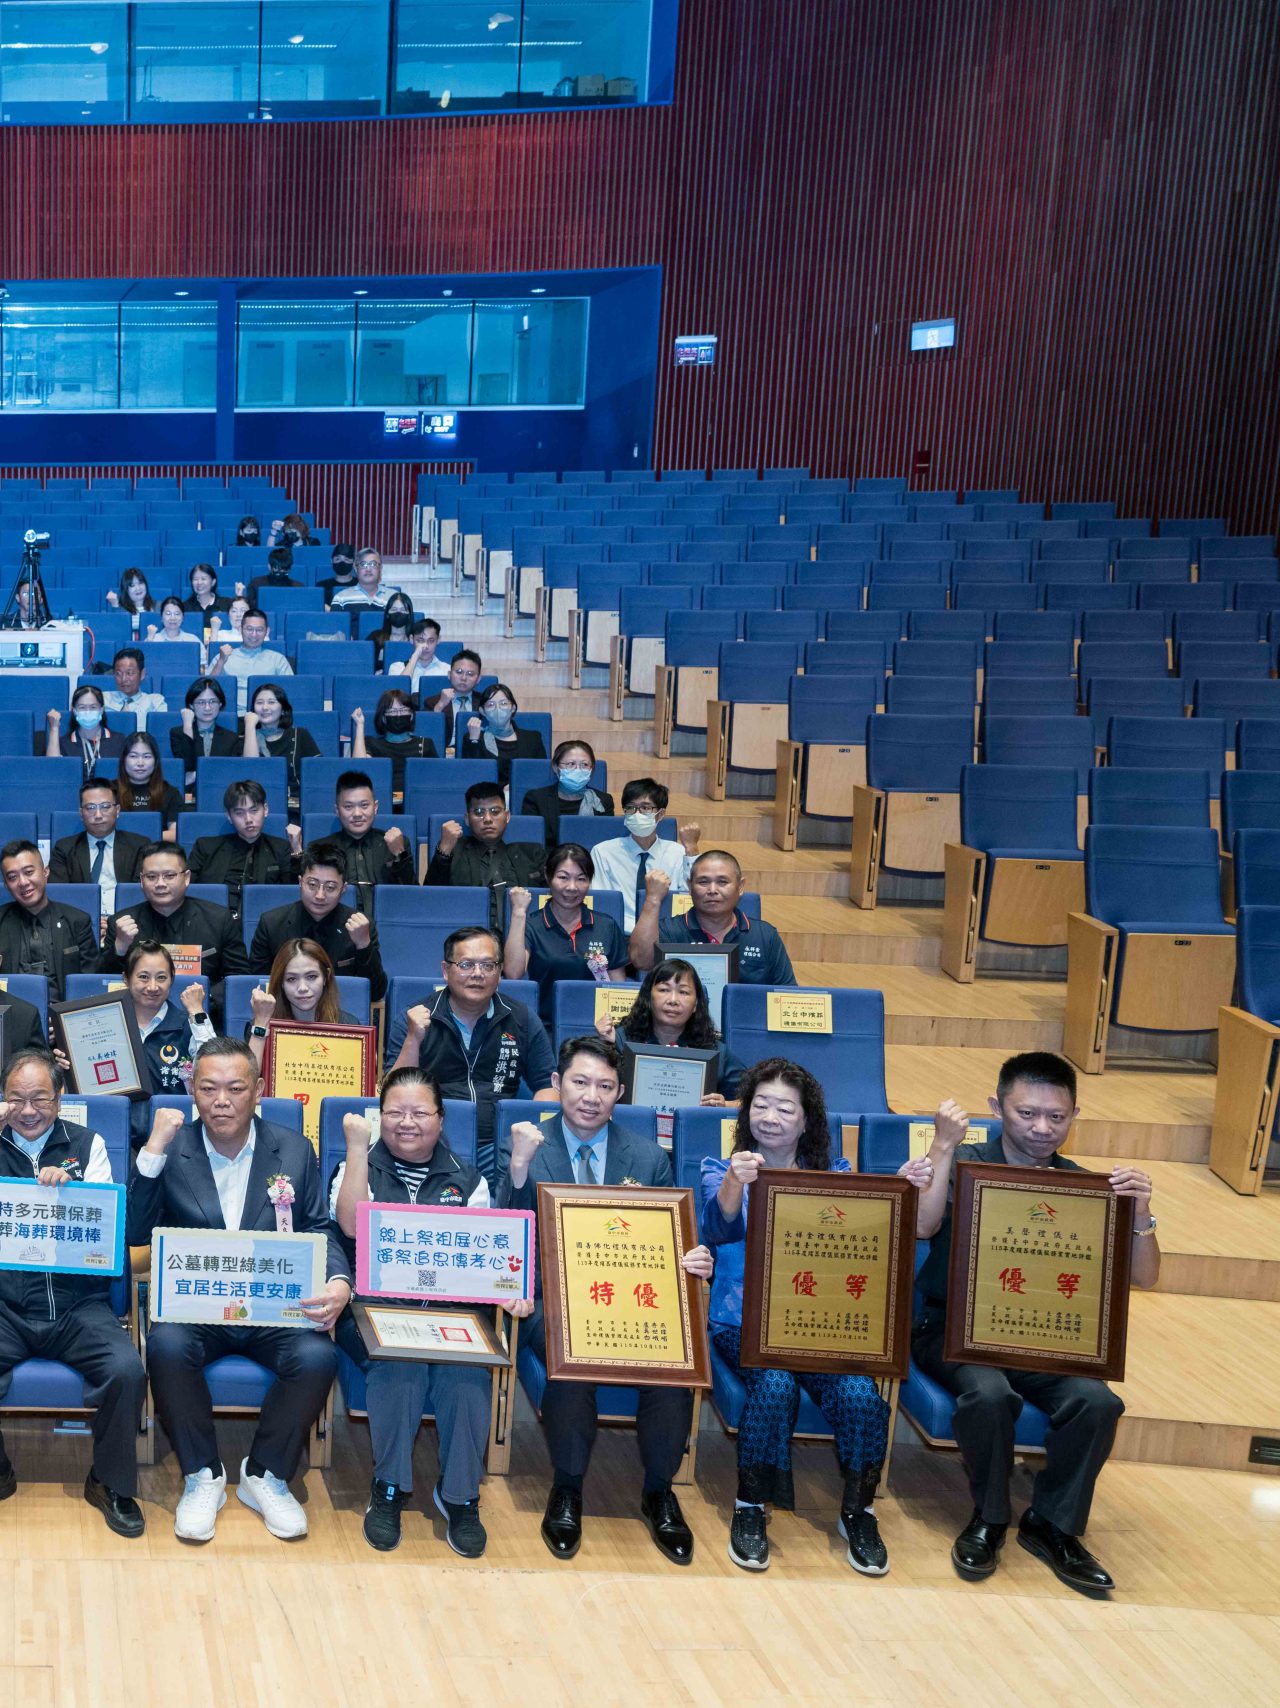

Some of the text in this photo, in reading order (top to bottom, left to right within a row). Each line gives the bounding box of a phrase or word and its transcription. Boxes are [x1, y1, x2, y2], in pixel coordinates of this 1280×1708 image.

[378, 1226, 511, 1250] 線上祭祖展心意
[166, 1253, 295, 1275] 公墓轉型綠美化
[376, 1247, 507, 1271] 遙祭追思傳孝心
[174, 1278, 303, 1300] 宜居生活更安康
[589, 1280, 661, 1309] 特優
[791, 1270, 869, 1301] 優等
[998, 1266, 1082, 1300] 優等
